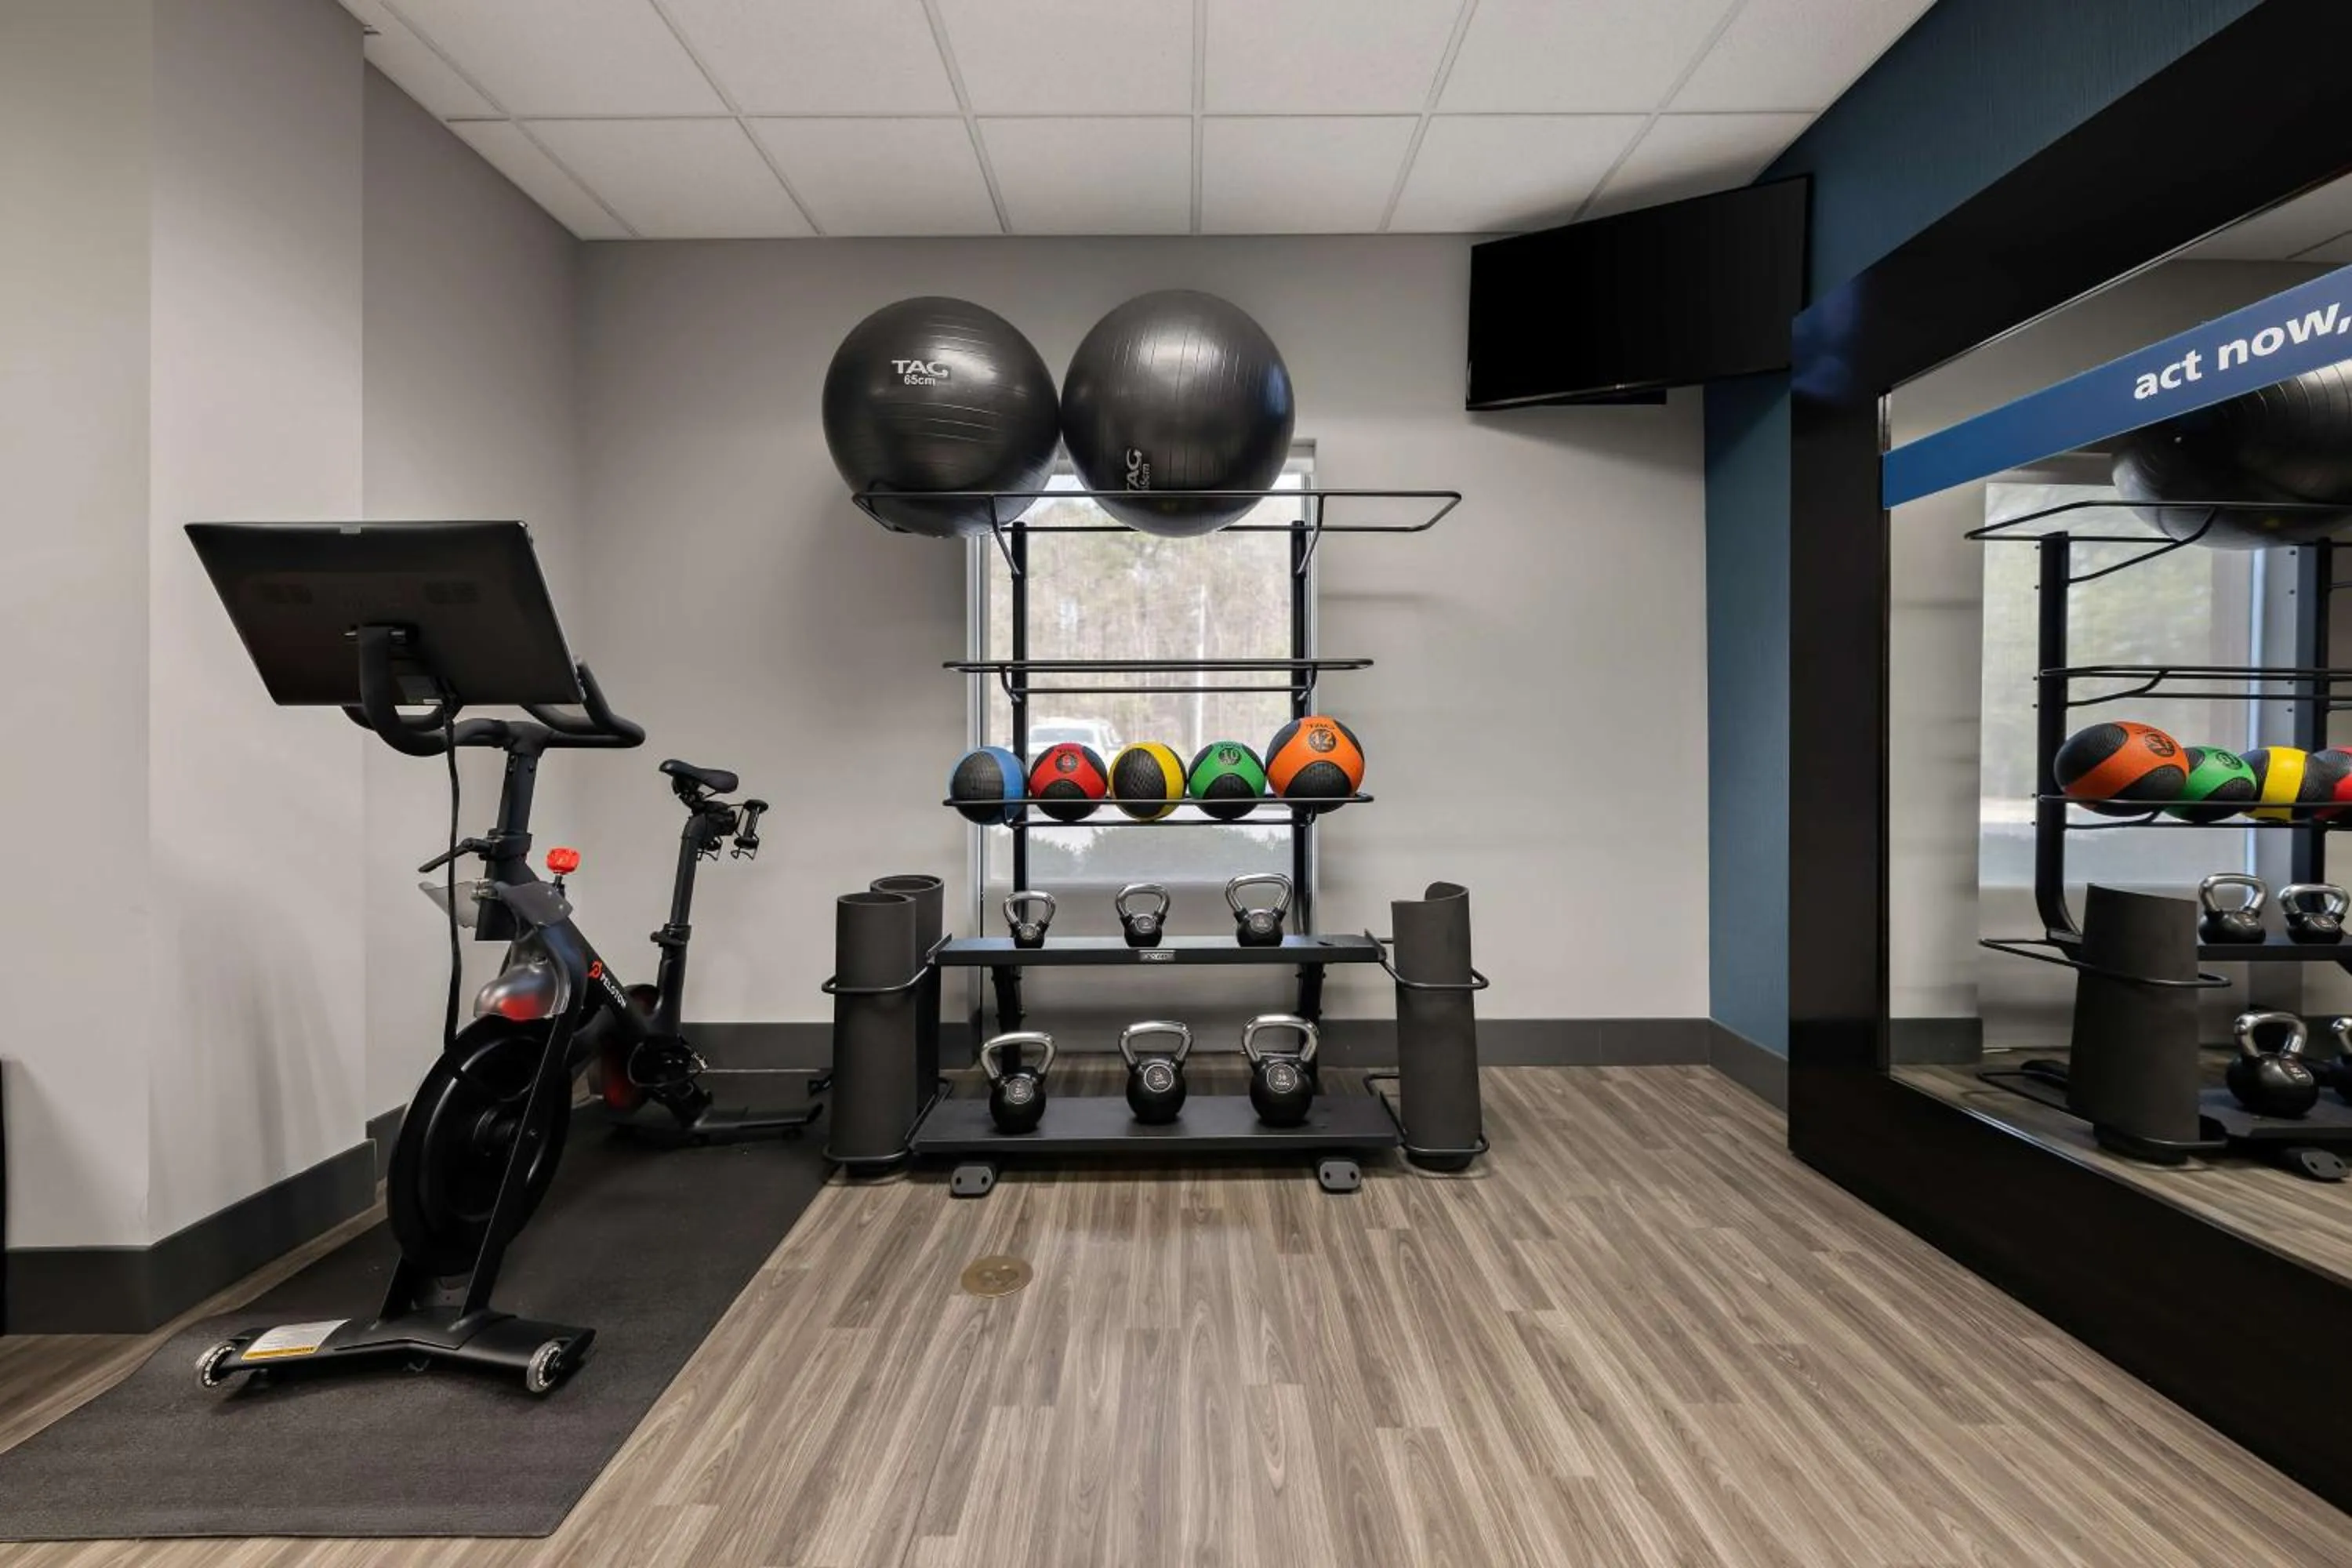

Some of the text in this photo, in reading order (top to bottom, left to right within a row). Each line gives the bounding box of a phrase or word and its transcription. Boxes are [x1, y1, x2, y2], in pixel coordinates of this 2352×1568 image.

[891, 360, 948, 377] TAG
[2133, 348, 2202, 400] act
[904, 374, 935, 386] 65cm
